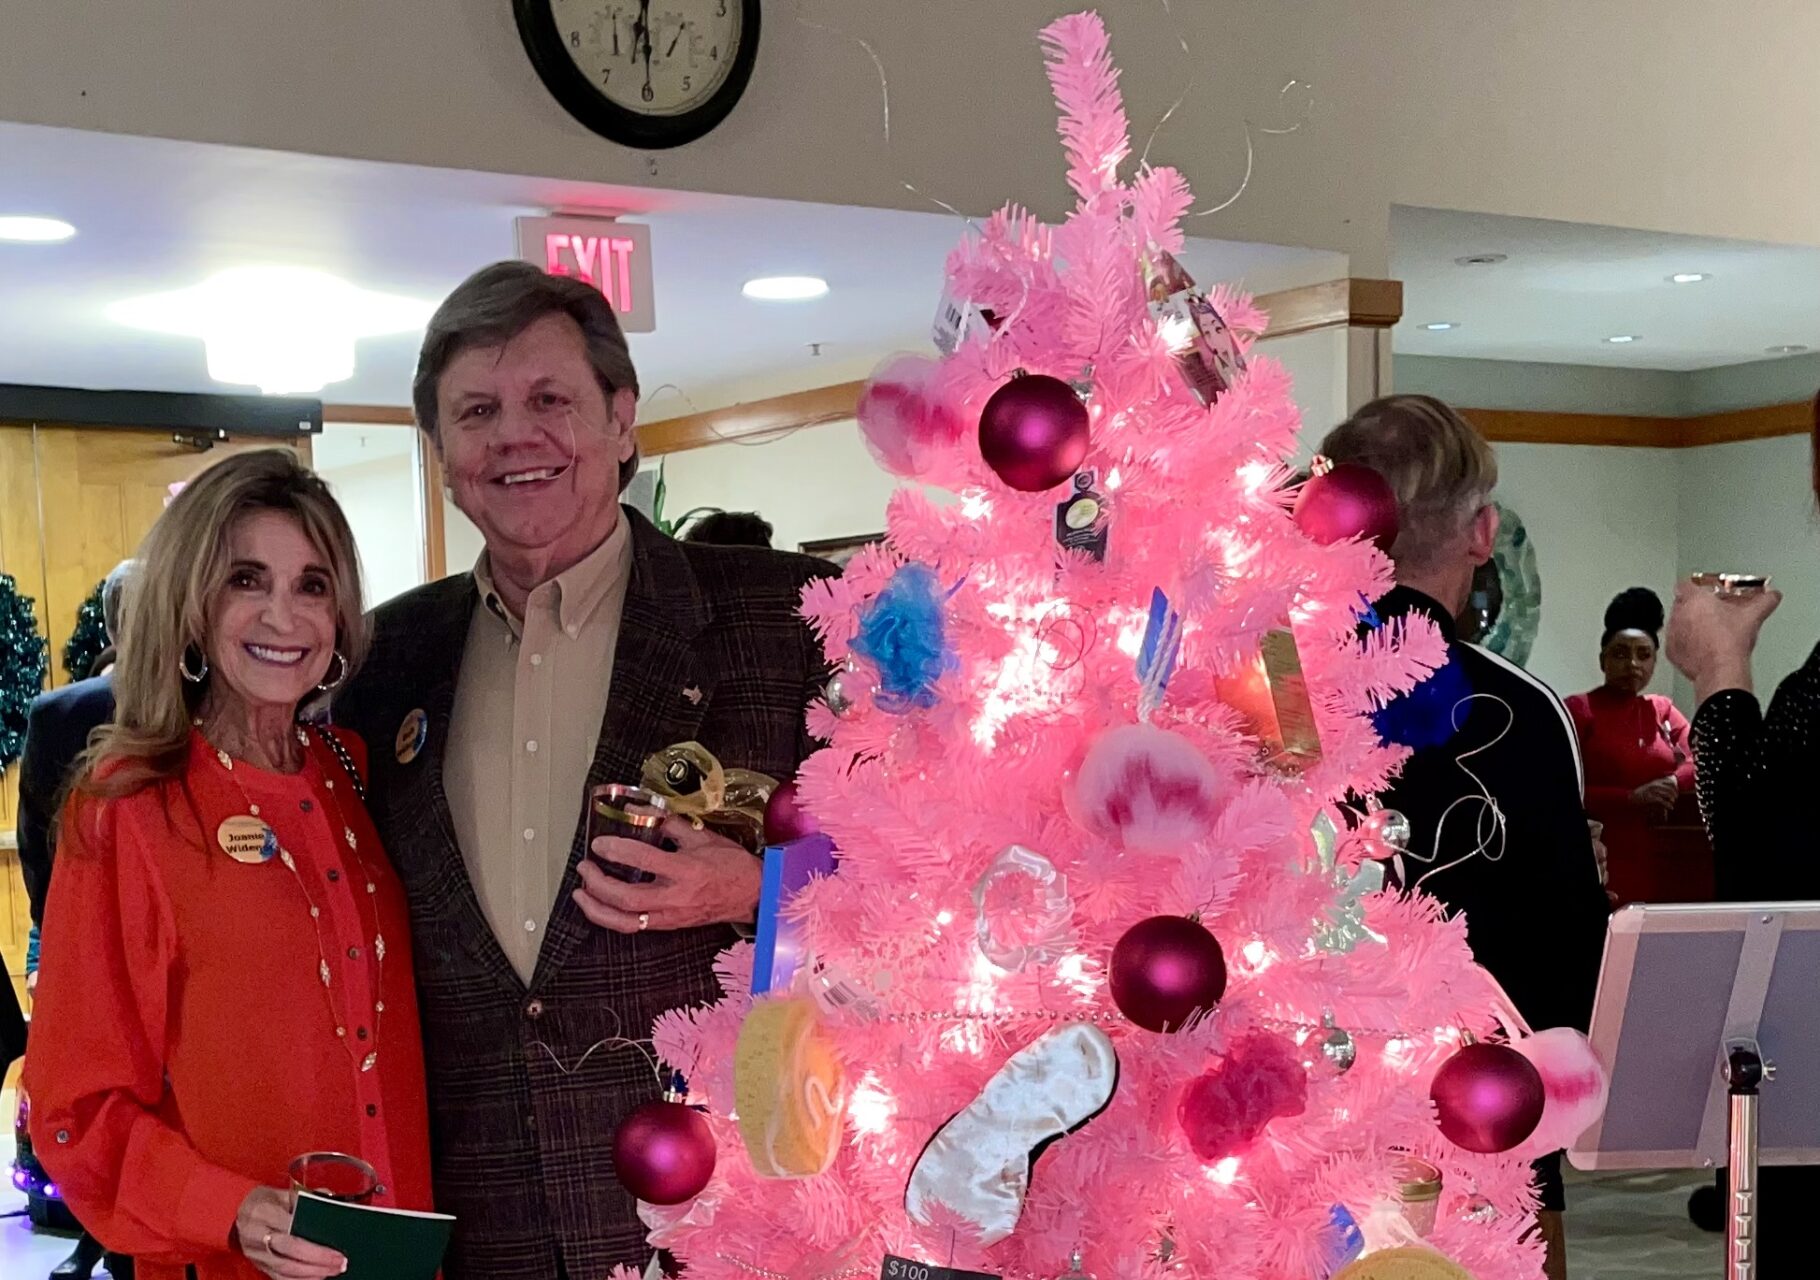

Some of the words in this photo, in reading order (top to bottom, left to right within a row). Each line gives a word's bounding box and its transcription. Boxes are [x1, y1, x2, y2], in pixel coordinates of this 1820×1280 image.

[571, 31, 580, 48] 8
[710, 45, 718, 61] 4
[602, 68, 612, 84] 7
[681, 75, 691, 91] 5
[546, 234, 634, 312] EXIT
